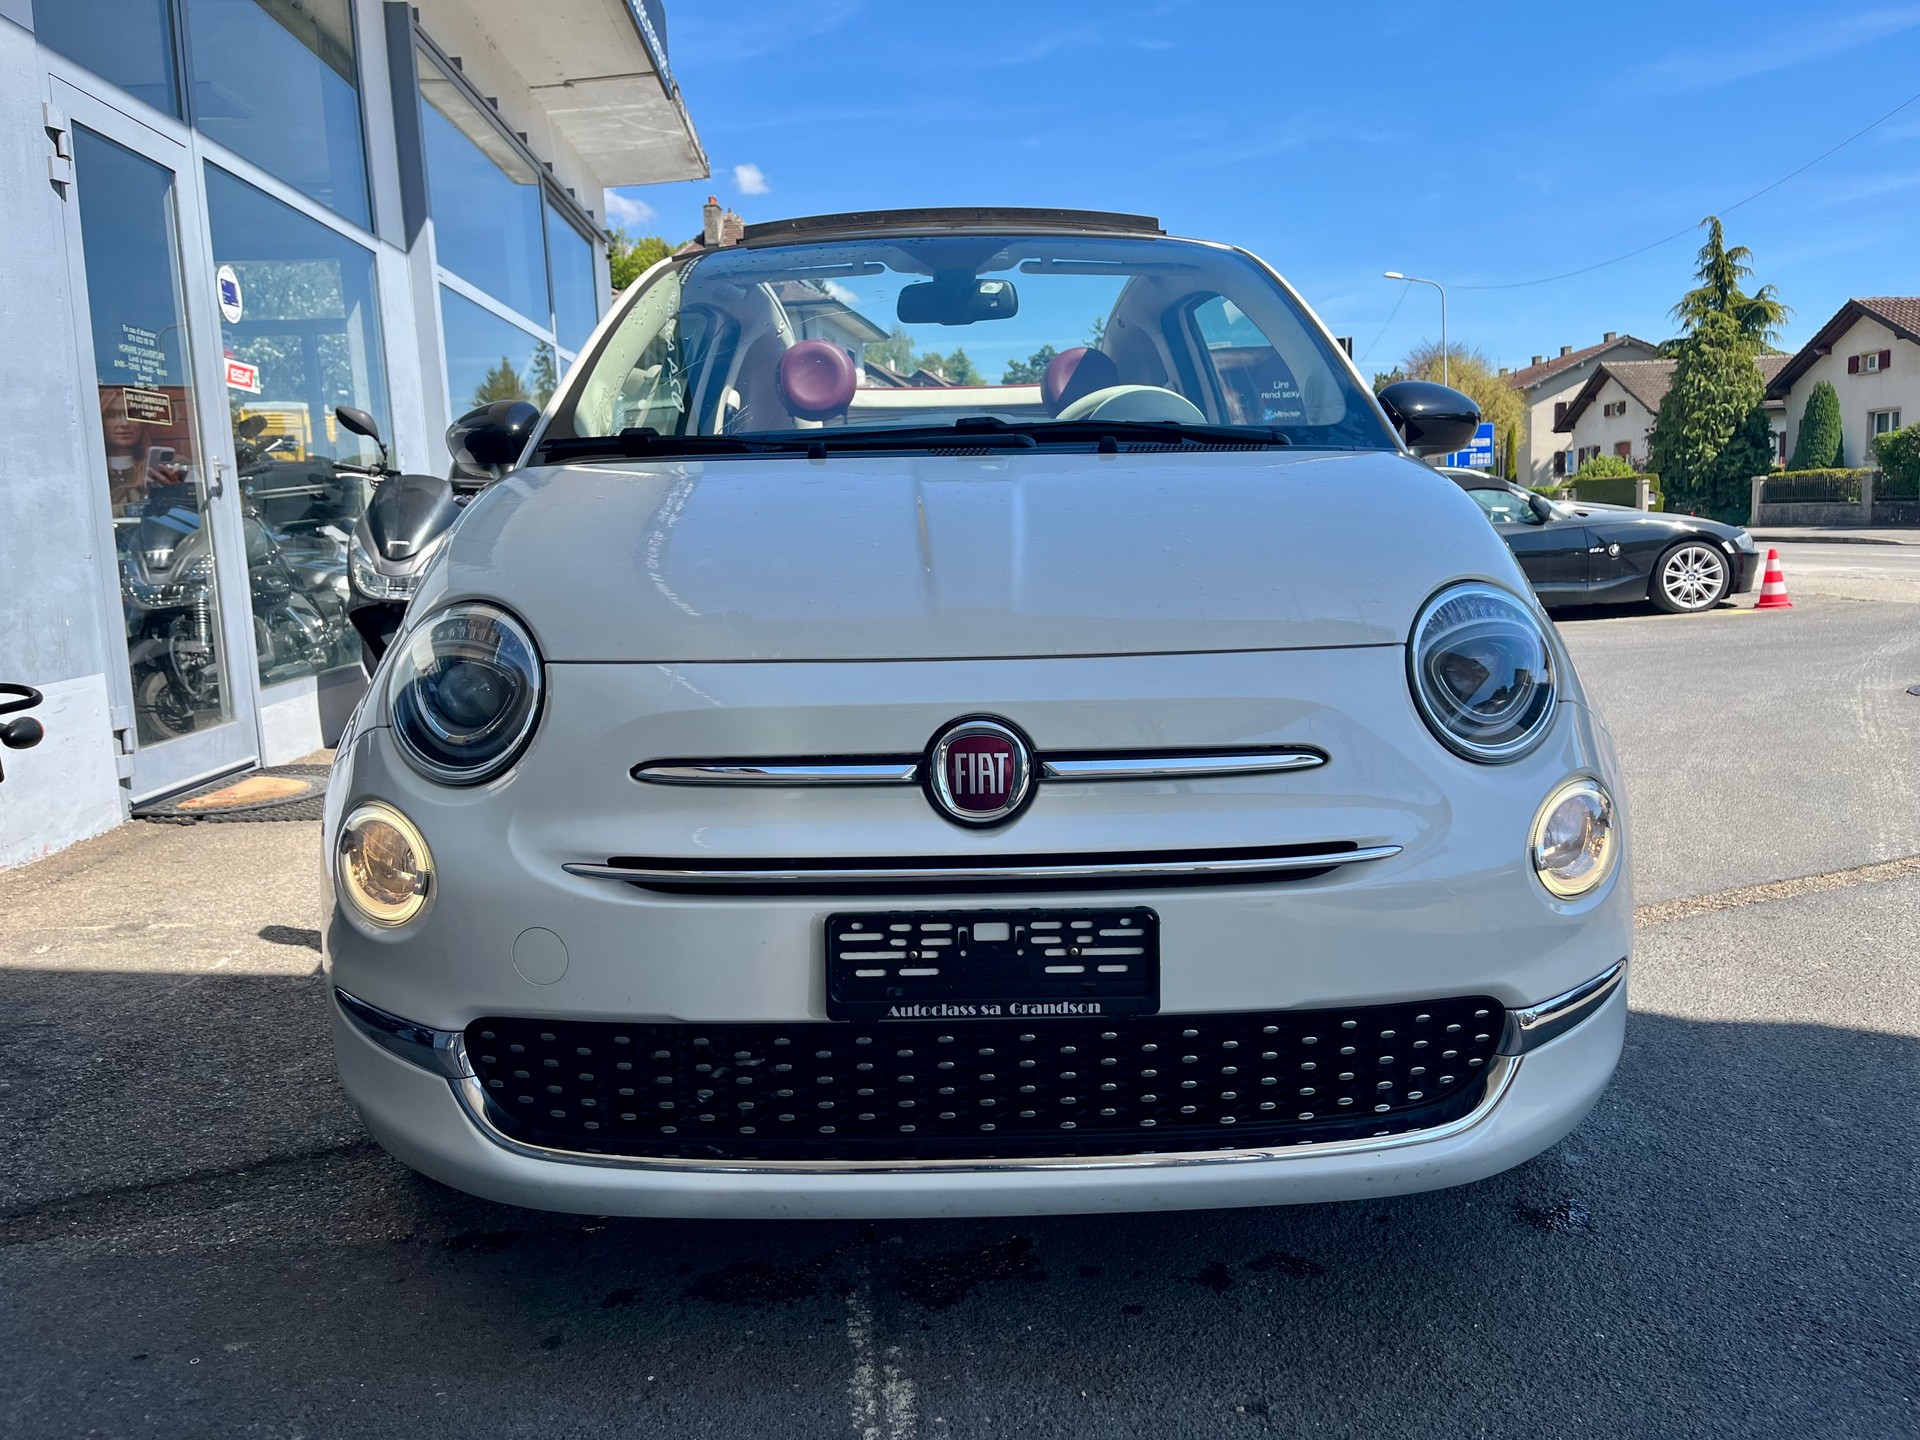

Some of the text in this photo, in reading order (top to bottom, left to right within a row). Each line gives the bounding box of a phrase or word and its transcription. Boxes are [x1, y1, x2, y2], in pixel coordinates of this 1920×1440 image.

[1273, 380, 1290, 390] Lire
[1261, 390, 1300, 399] rend sexy
[954, 752, 1009, 794] FIAT
[887, 1001, 1101, 1018] Autoclass sa Grandson
